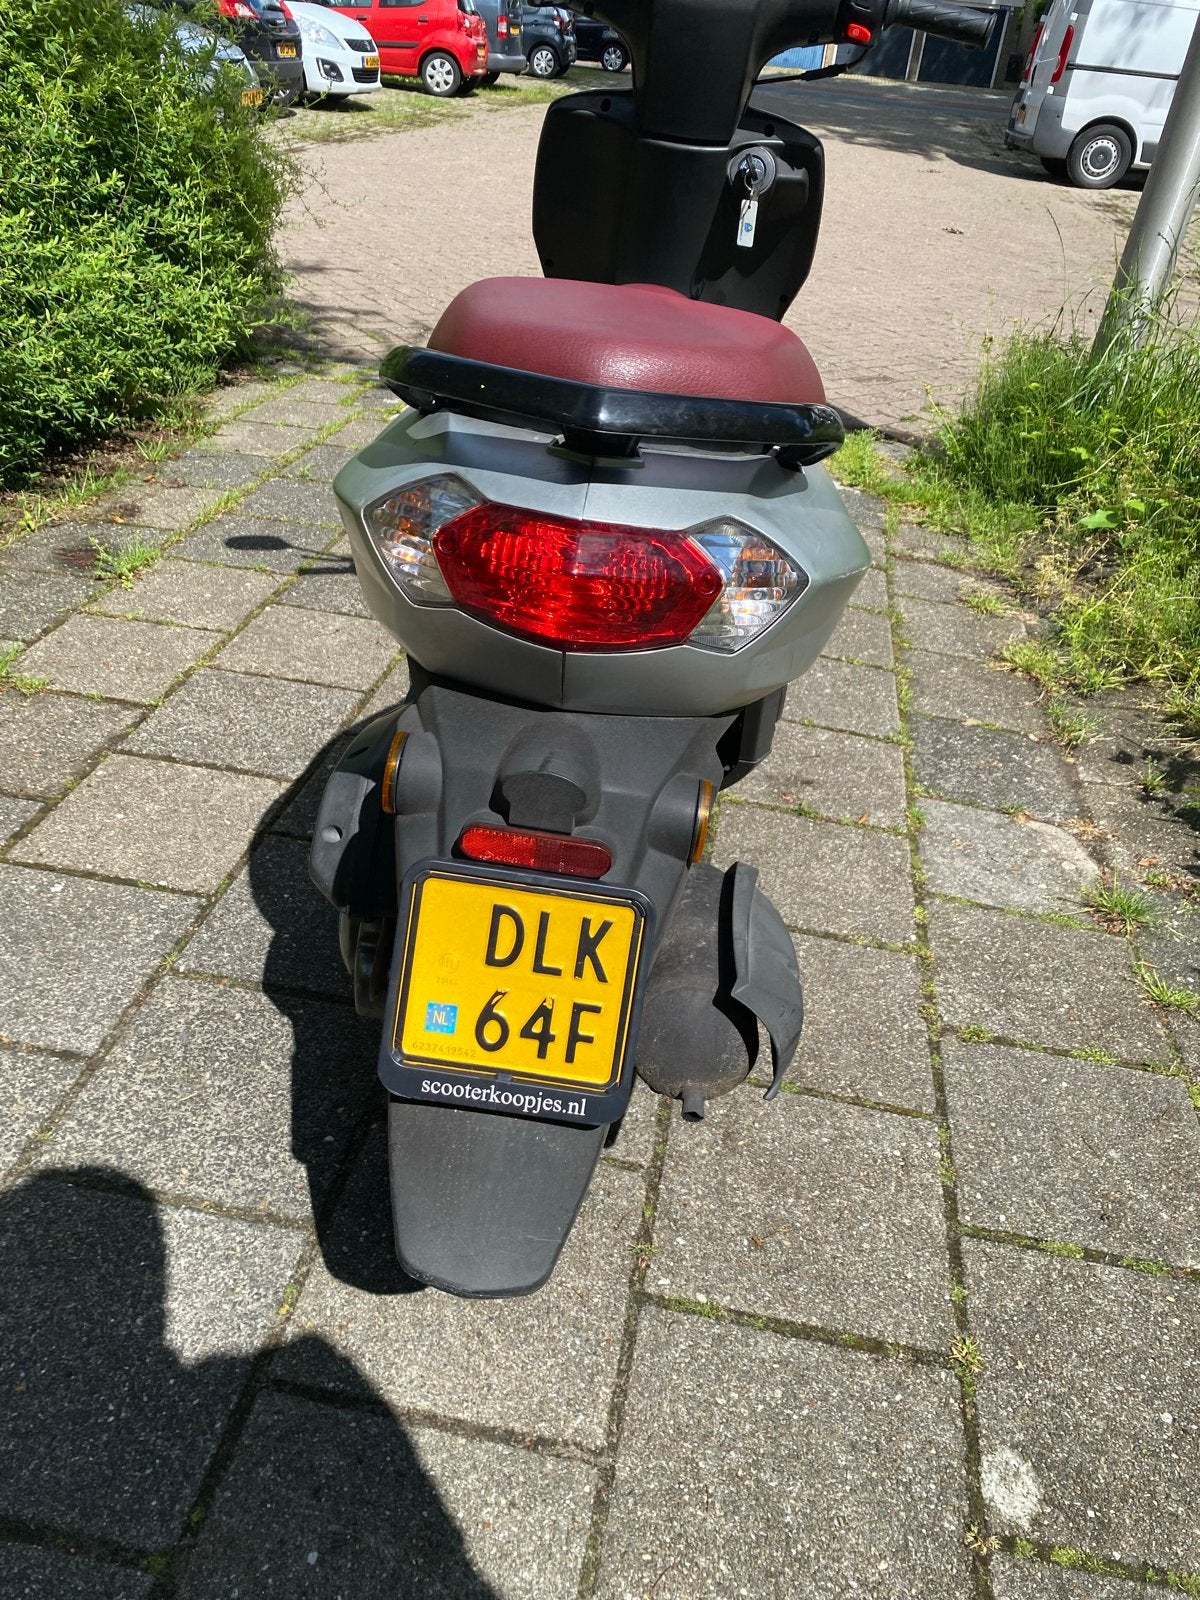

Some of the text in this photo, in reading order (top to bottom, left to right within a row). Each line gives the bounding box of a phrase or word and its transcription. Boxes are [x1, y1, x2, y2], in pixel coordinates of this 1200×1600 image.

[485, 903, 614, 983] DLK
[432, 1010, 449, 1026] NL
[475, 988, 602, 1064] 64F
[412, 1040, 477, 1058] 6237419542
[420, 1078, 587, 1117] scooterkoopjes.nl
